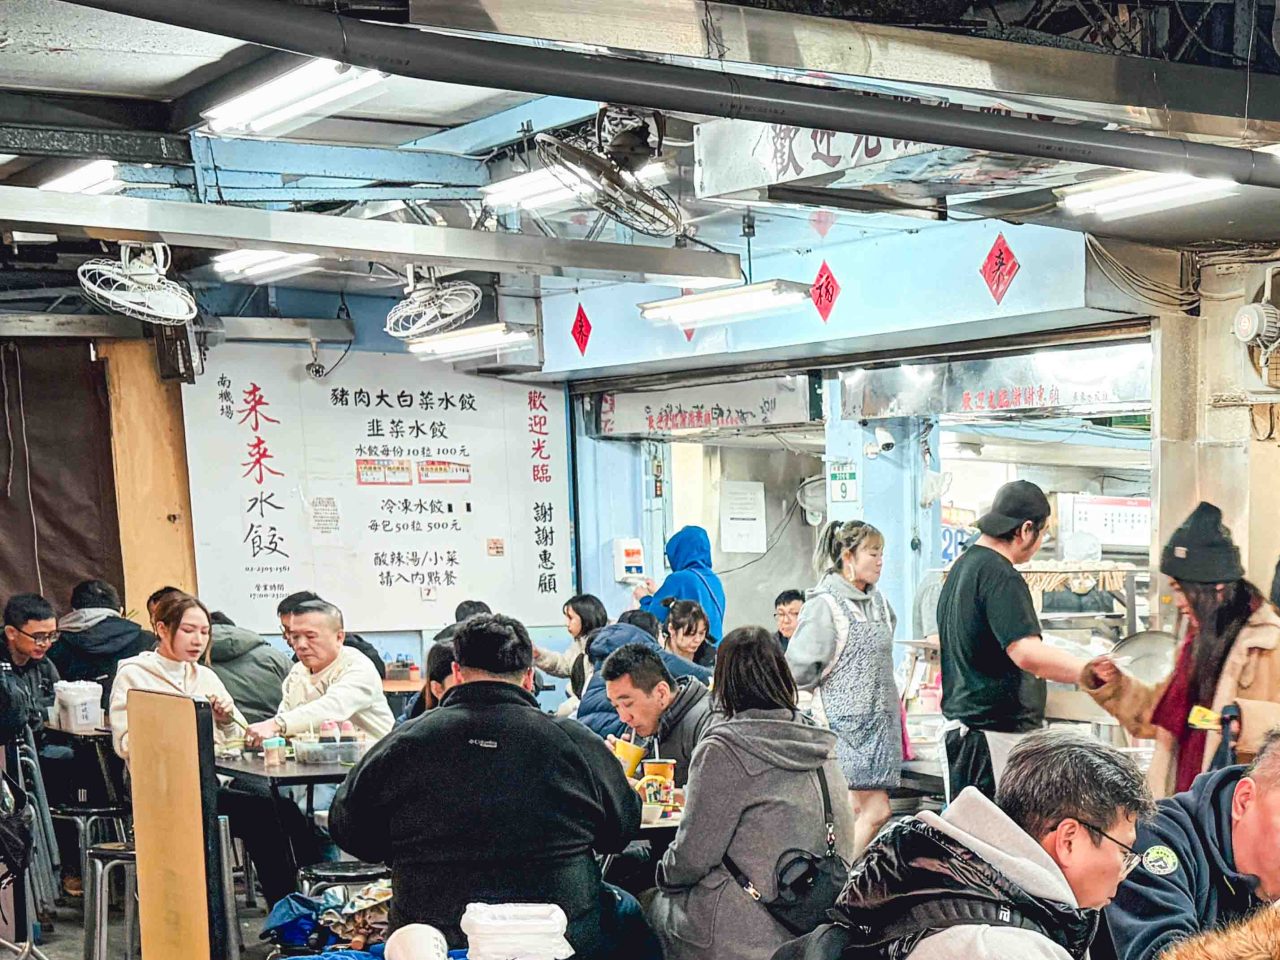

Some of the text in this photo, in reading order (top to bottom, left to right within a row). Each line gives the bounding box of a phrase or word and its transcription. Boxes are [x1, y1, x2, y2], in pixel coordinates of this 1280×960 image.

[217, 373, 234, 419] 南機場
[330, 386, 478, 411] 豬肉大白菜水餃
[367, 418, 449, 439] 韭菜水餃
[437, 445, 470, 458] 100元
[528, 389, 557, 594] 歡迎光臨 謝謝惠顧
[840, 482, 848, 499] 9
[380, 498, 445, 514] 冷凍水餃
[368, 519, 462, 532] 每包50粒 500元
[373, 550, 460, 567] 酸辣湯/小菜
[378, 571, 458, 586] 請入內點餐
